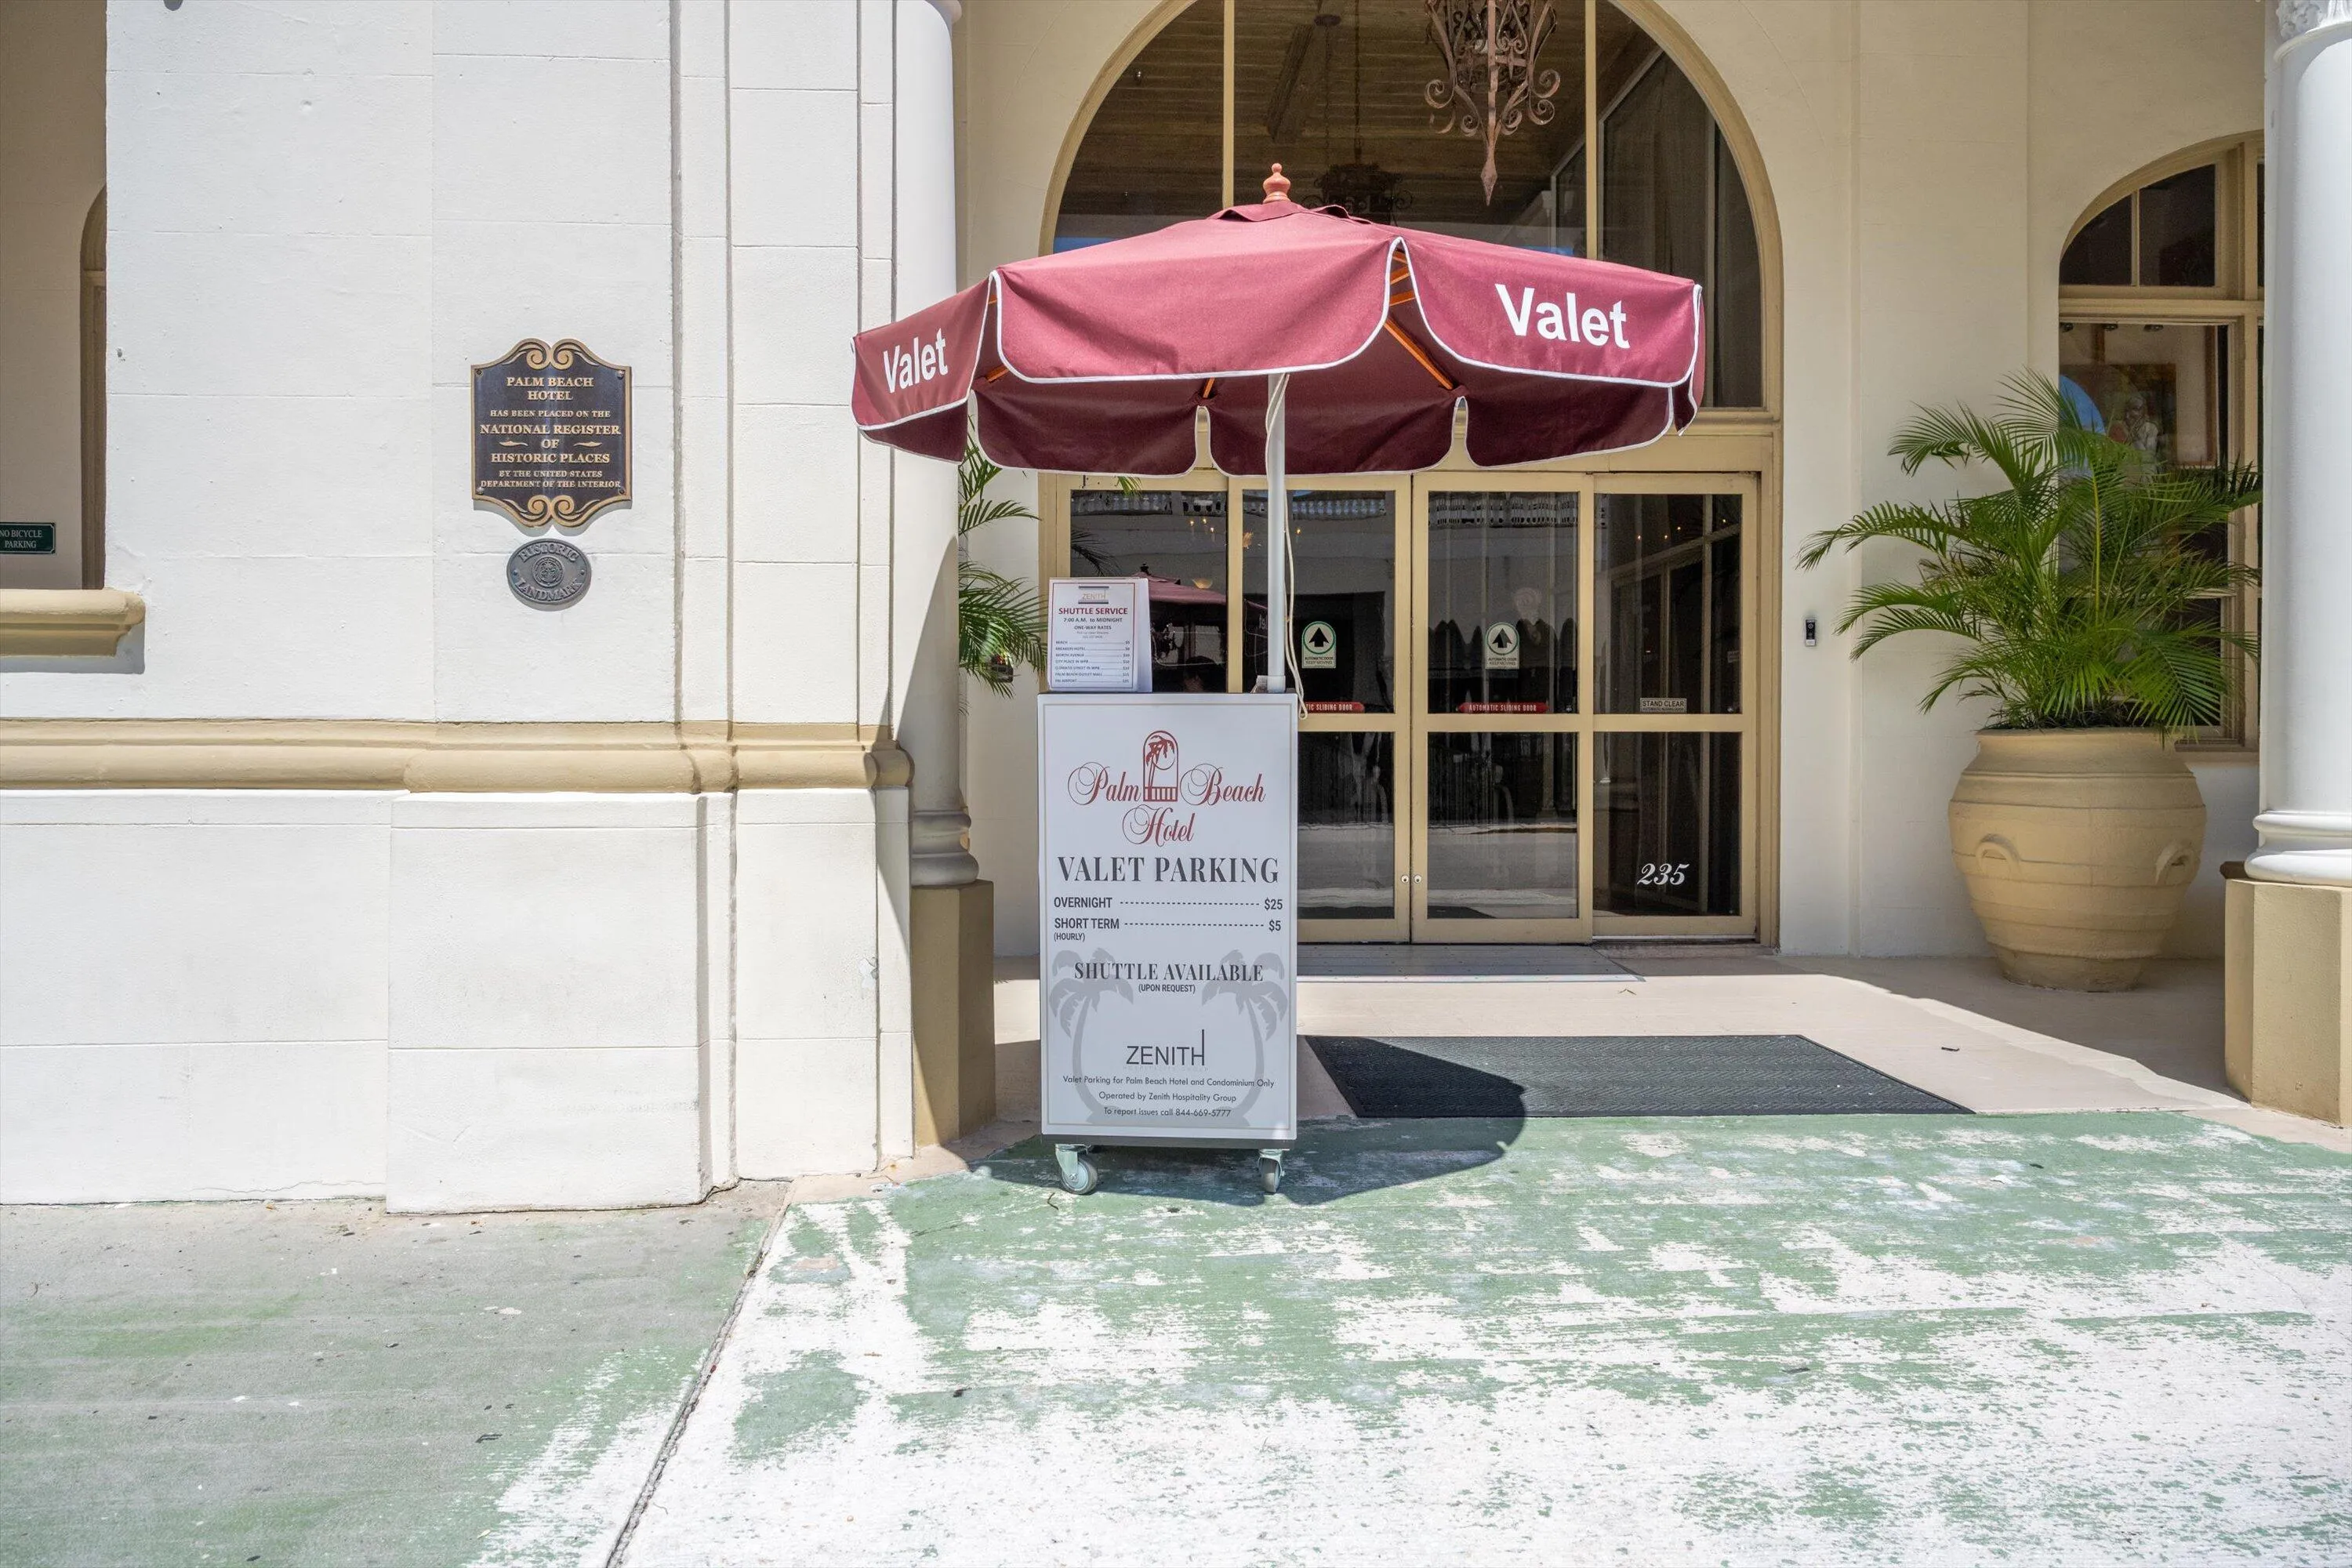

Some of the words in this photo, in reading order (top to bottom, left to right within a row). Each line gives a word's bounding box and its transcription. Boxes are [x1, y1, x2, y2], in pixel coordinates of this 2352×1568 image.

[1495, 283, 1630, 349] Valet
[884, 328, 948, 394] Valet
[506, 377, 545, 387] PALM
[547, 377, 594, 387] BEACH
[528, 390, 573, 401] HOTEL
[480, 424, 550, 434] NATIONAL
[554, 424, 621, 435] REGISTER
[541, 439, 560, 449] OF
[491, 453, 557, 463] HISTORIC
[560, 453, 611, 463] PLACES
[5, 540, 37, 549] PARKING
[518, 543, 579, 563] HISTORIC
[515, 578, 583, 601] LANDMARK
[1082, 590, 1106, 600] ZENITH
[1067, 761, 1143, 806] Palm
[1179, 763, 1266, 806] Beach
[1122, 804, 1196, 848] Hotel
[1057, 856, 1145, 882] VALET
[1154, 857, 1279, 884] PARKING
[1637, 863, 1690, 885] 235
[1054, 897, 1112, 908] OVERNIGHT
[1264, 898, 1283, 911] $25
[1054, 917, 1089, 929] SHORT
[1091, 918, 1120, 929] TERM
[1269, 920, 1281, 931] $5
[1054, 932, 1085, 942] (HOURLY)
[1074, 962, 1158, 980] SHUTTLE
[1163, 964, 1263, 982] AVAILABLE
[1138, 984, 1160, 993] (UPON
[1161, 984, 1196, 994] REQUEST)
[1126, 1029, 1205, 1066] ZENITH
[1083, 1076, 1111, 1085] Parking
[1207, 1078, 1255, 1087] Condominium
[1257, 1079, 1275, 1088] Only
[1098, 1091, 1135, 1100] Operated
[1138, 1092, 1146, 1101] by
[1172, 1093, 1210, 1102] Hospitality
[1212, 1094, 1236, 1103] Group
[1114, 1108, 1137, 1116] report
[1175, 1109, 1231, 1117] 844-669-5777
